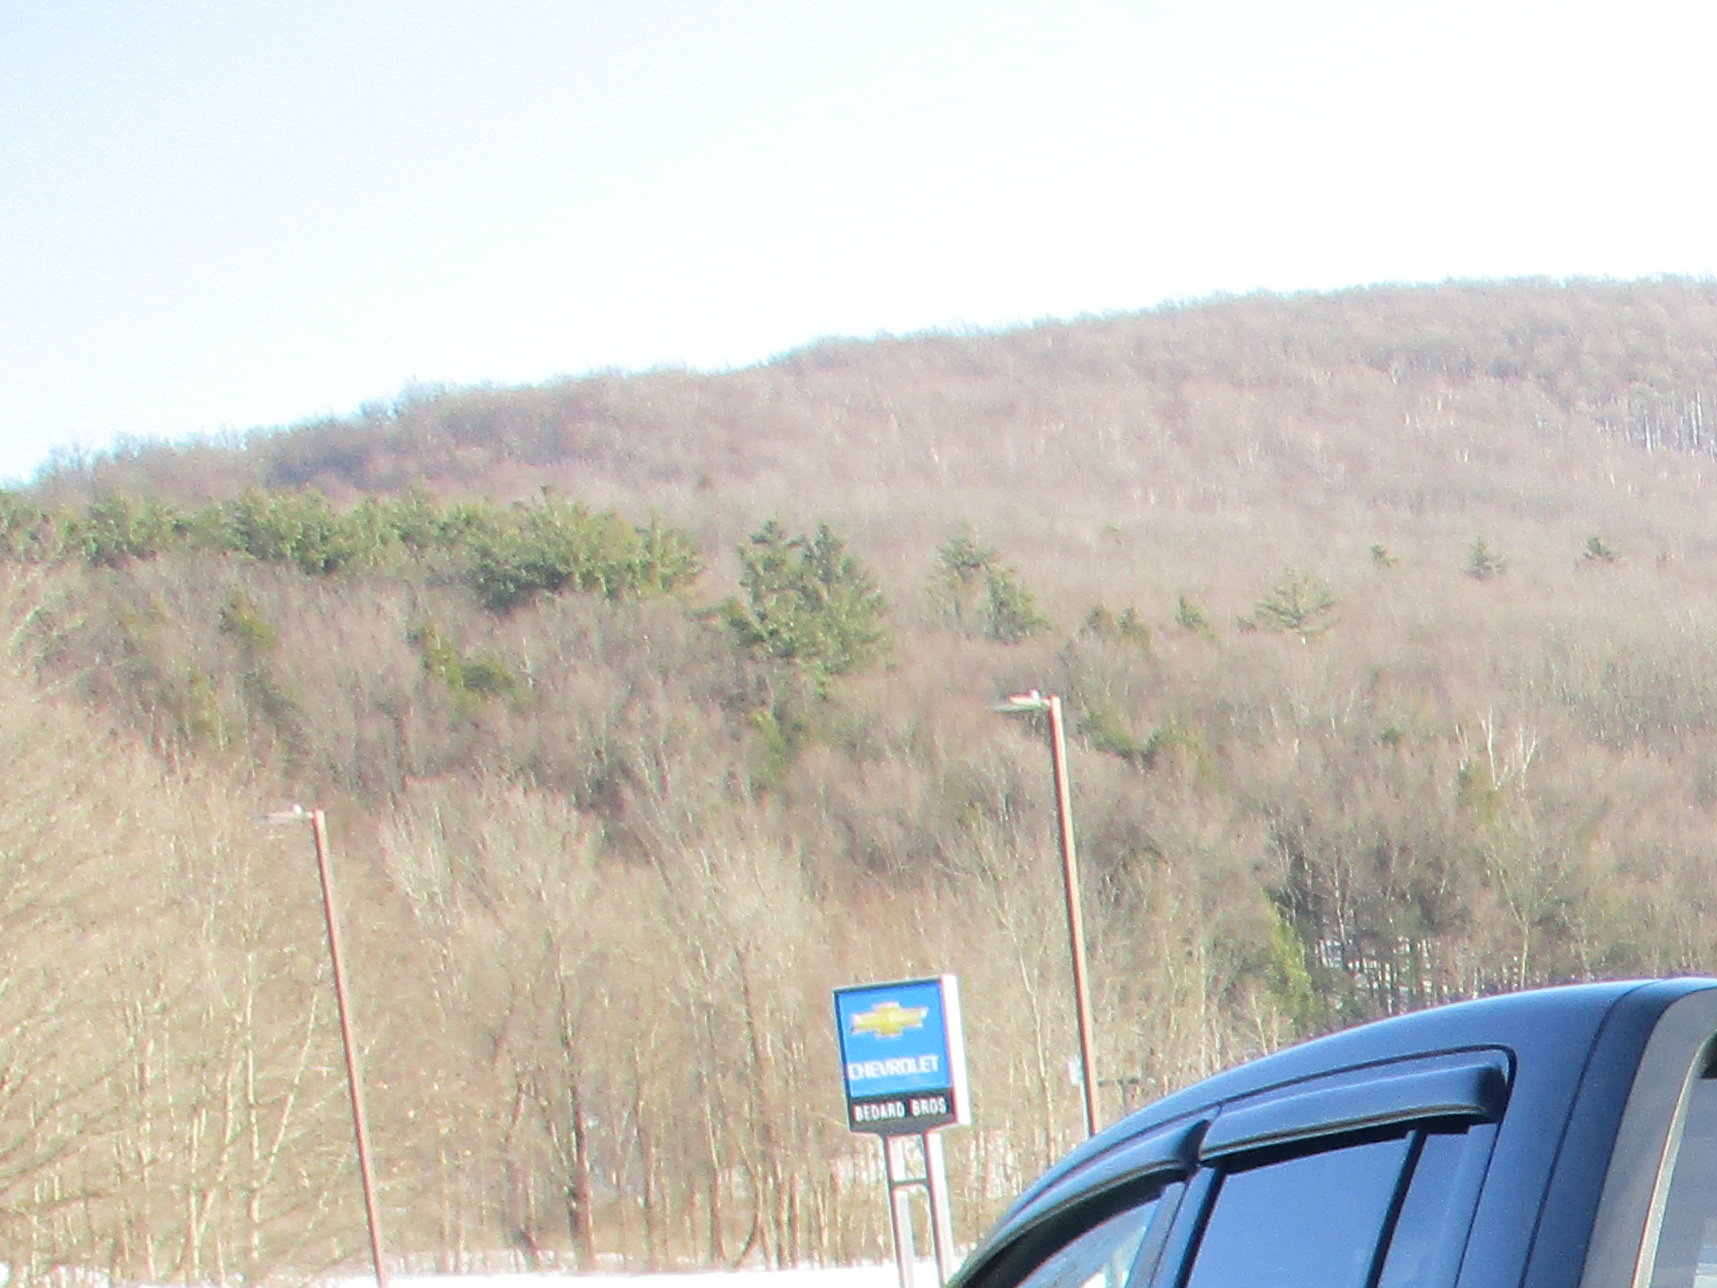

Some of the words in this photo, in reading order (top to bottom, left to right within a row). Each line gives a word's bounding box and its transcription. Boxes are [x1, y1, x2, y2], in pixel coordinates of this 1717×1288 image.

[849, 1054, 940, 1080] CHEVROLET
[854, 1101, 906, 1122] BEDARD
[911, 1096, 947, 1117] BROS
